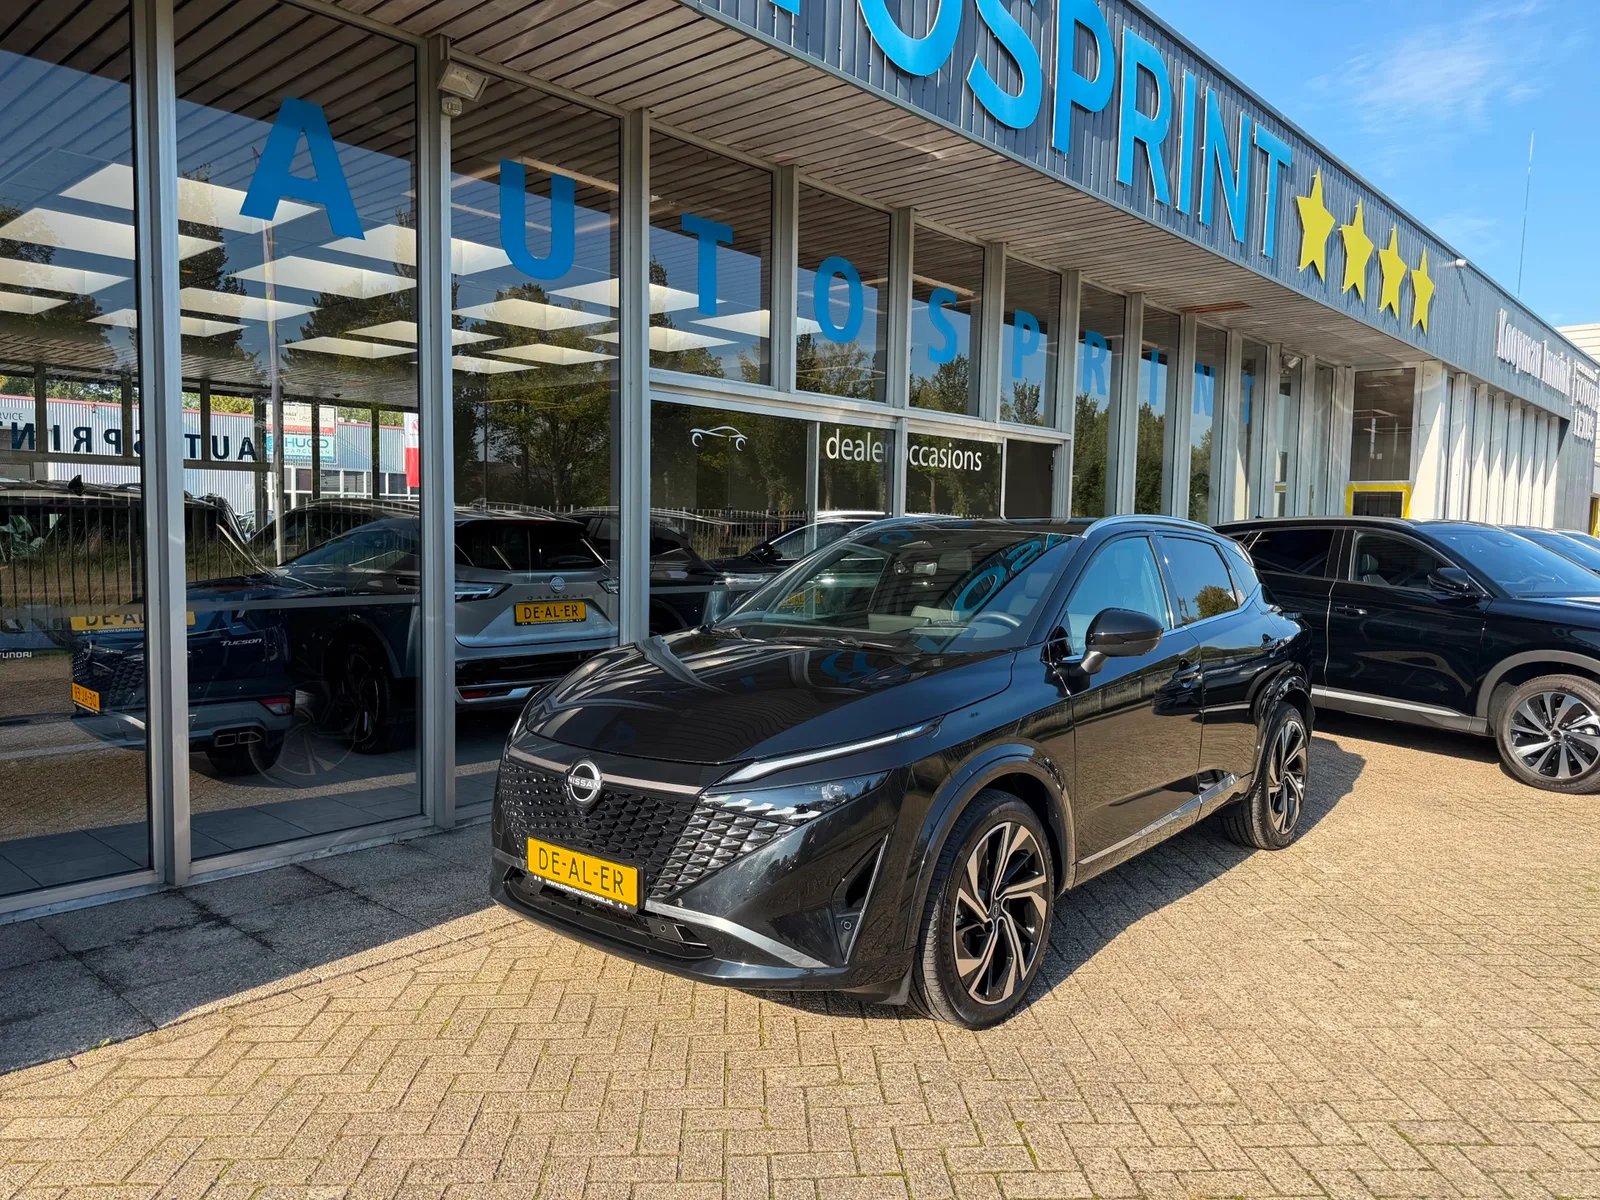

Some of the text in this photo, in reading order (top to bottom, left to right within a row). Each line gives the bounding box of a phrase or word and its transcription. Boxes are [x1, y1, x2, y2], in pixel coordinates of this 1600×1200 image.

[769, 0, 1292, 259] OSPRINT
[0, 412, 24, 421] RVICE
[906, 443, 982, 472] ccasions
[524, 605, 579, 620] DE-AL-ER
[0, 651, 32, 659] UNDAI
[568, 775, 600, 789] NISSAN
[538, 847, 624, 896] DE-AL-ER
